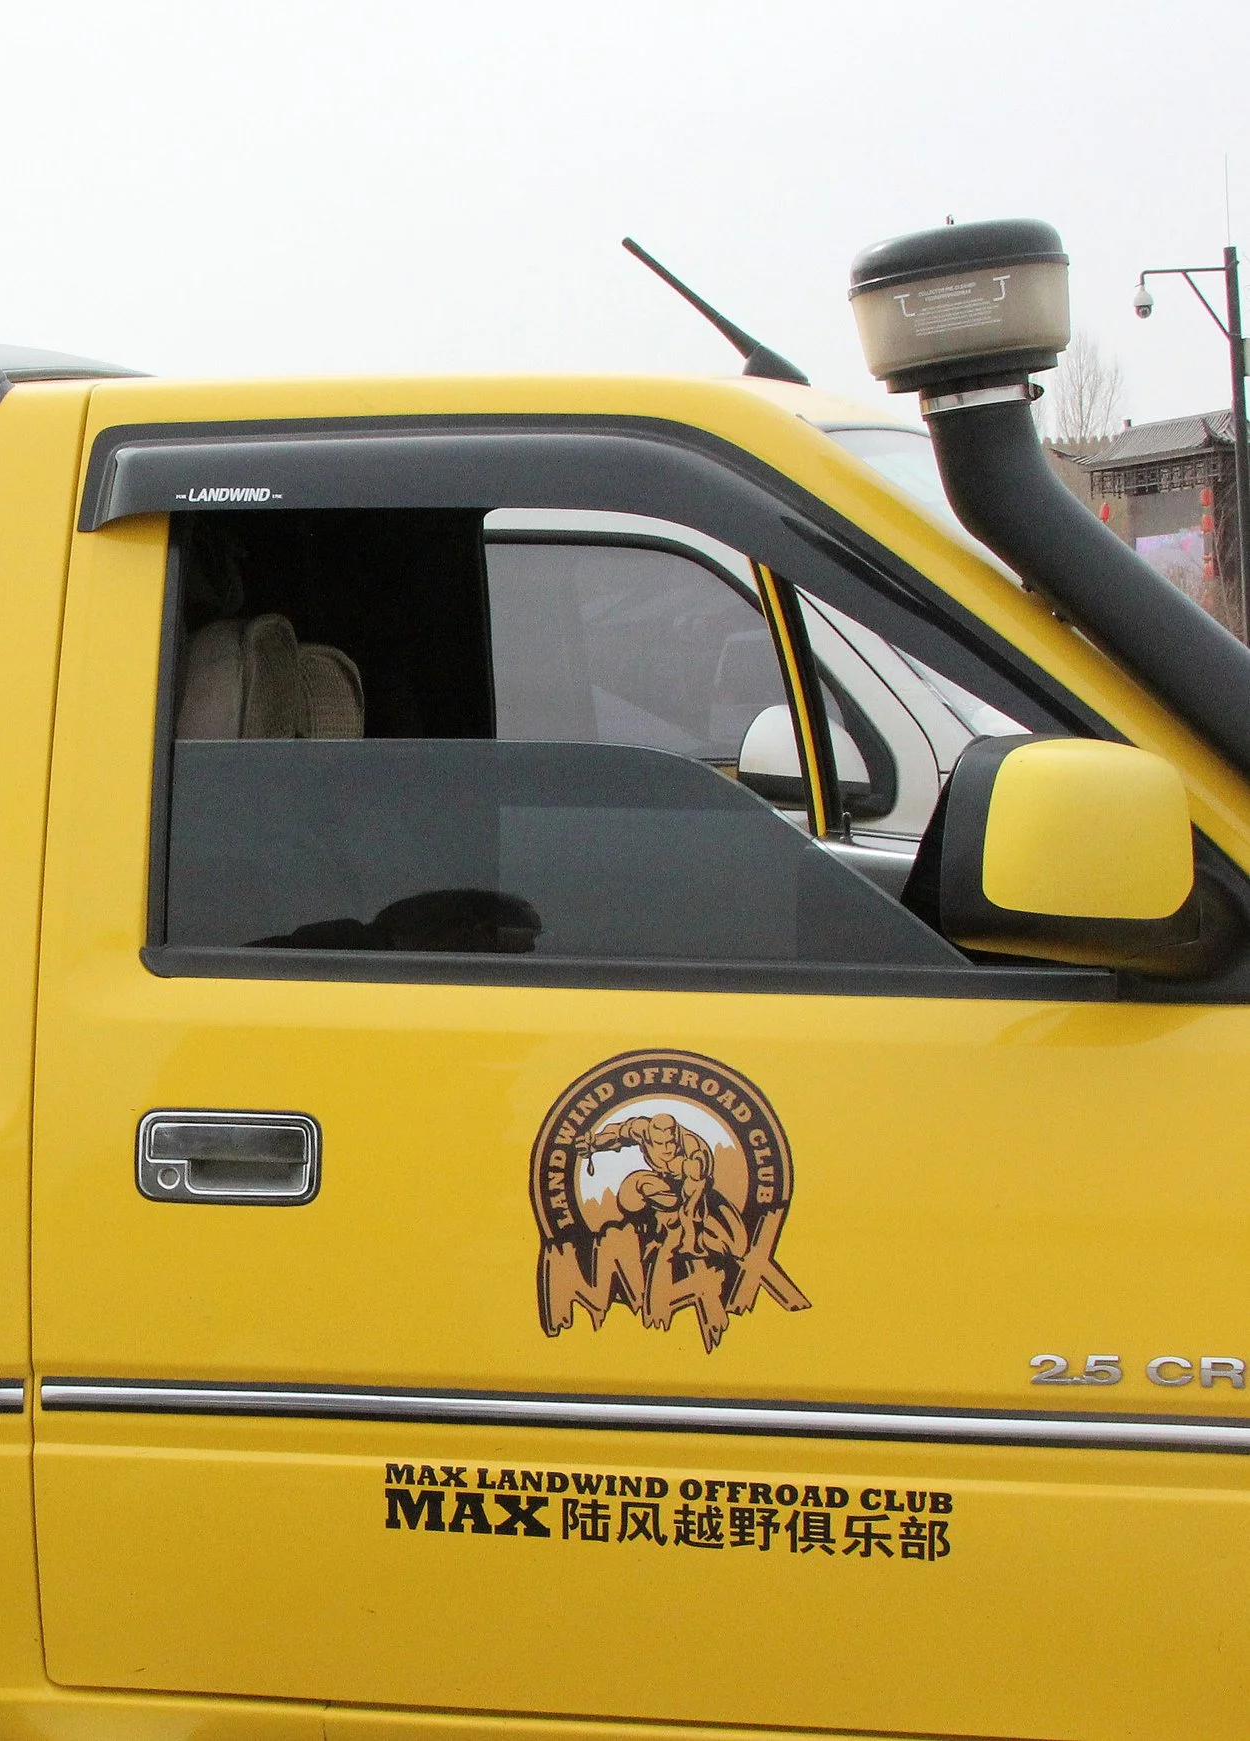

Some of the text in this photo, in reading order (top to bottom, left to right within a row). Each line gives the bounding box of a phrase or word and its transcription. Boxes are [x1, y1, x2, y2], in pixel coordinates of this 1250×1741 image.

[189, 488, 270, 502] LANDWIND
[622, 1066, 753, 1124] OFFROAD
[749, 1129, 776, 1204] CLUB
[538, 1208, 812, 1354] MAX
[1029, 1354, 1122, 1386] 2.5
[384, 1463, 953, 1514] MAX LANDWIND OFFROAD CLUB
[384, 1487, 951, 1562] MAX 陆风越野俱乐部
